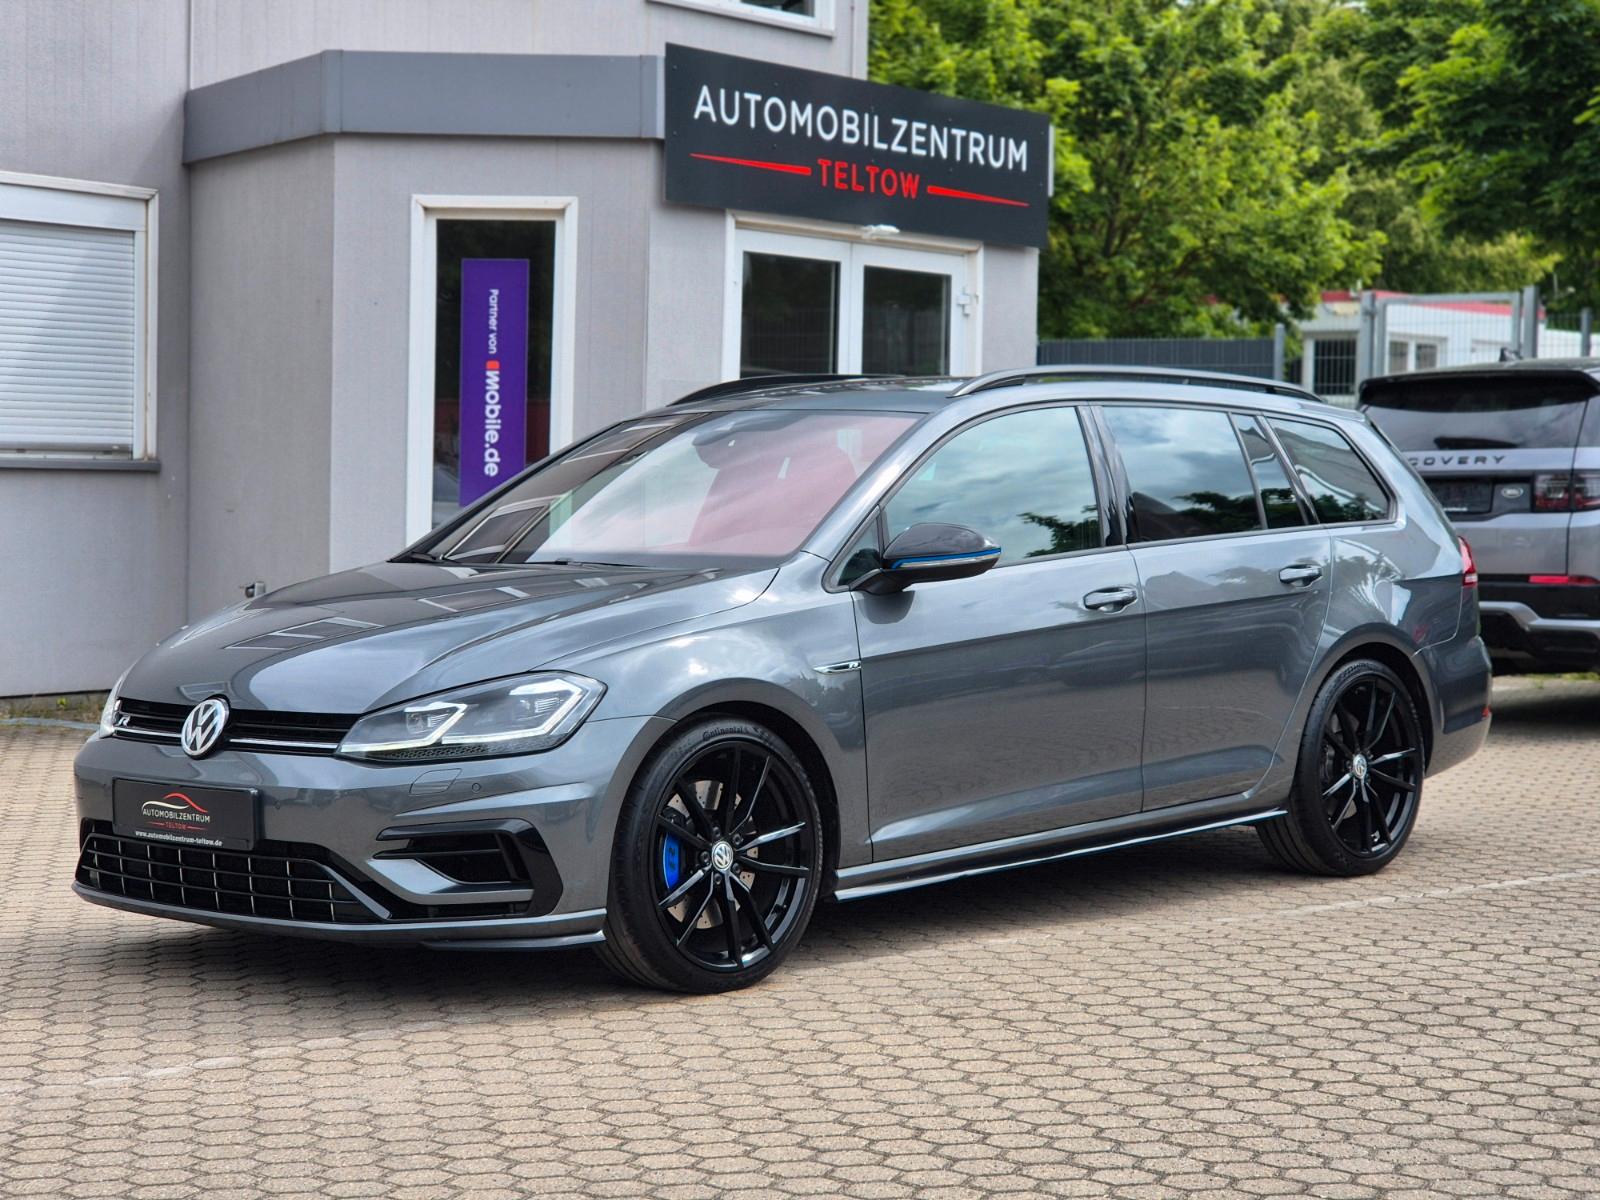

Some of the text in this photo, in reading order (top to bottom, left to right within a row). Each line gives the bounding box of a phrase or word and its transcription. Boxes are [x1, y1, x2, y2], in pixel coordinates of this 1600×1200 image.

[693, 85, 1028, 172] AUTOMOBILZENTRUM
[817, 158, 920, 199] TELTOW
[488, 288, 500, 354] Partner von
[484, 361, 501, 477] mobile.de
[1408, 455, 1506, 466] COVERY
[142, 808, 210, 823] AUTOMOBILZENTRUM
[135, 830, 223, 847] www.automobilzentrum-teltow.de
